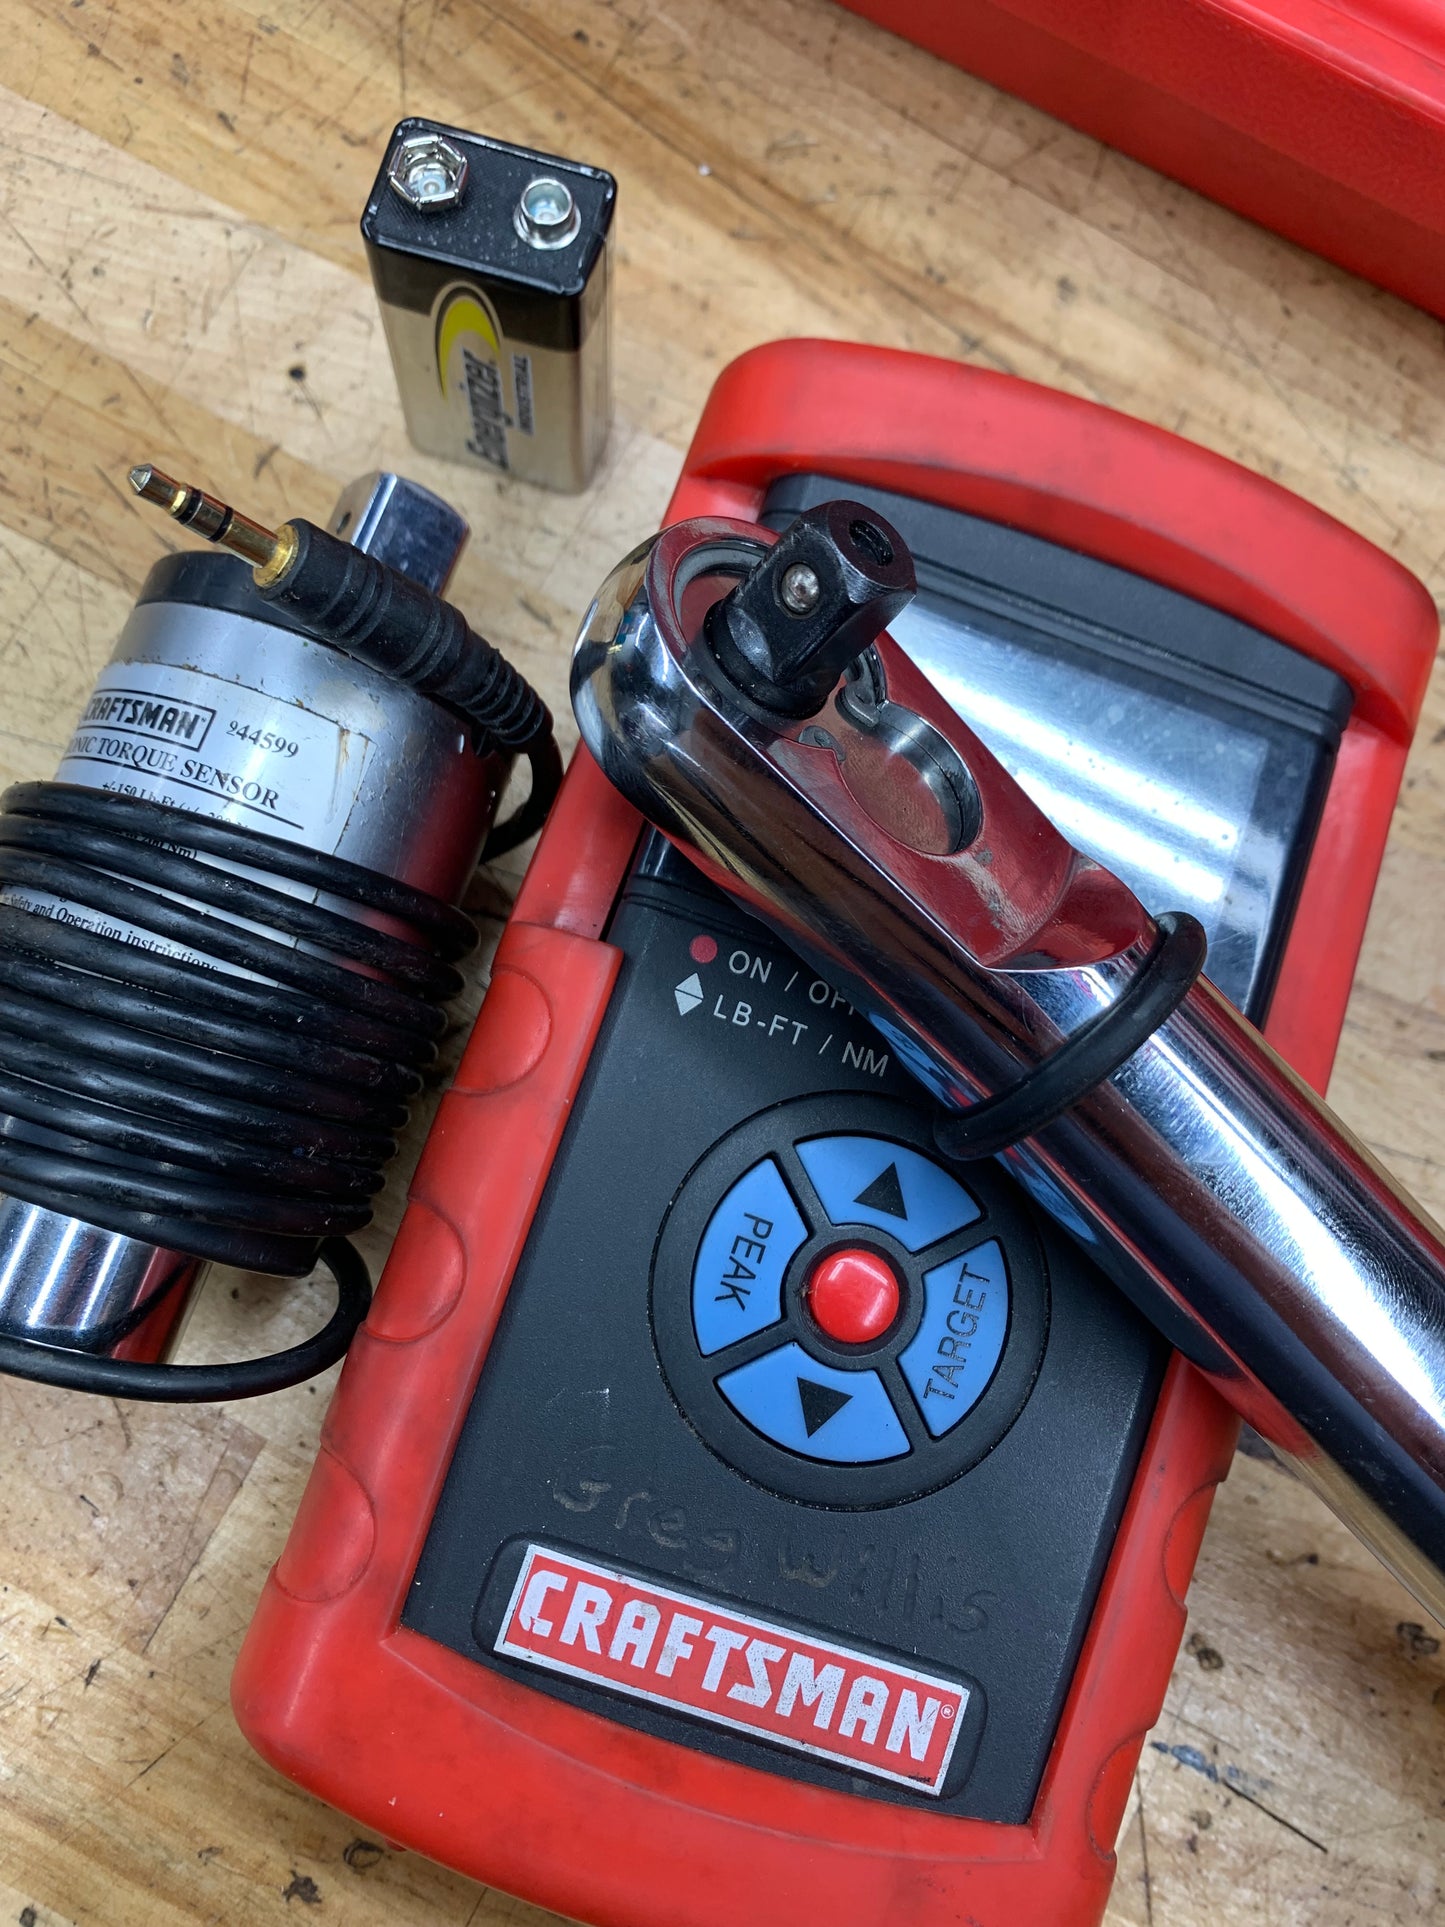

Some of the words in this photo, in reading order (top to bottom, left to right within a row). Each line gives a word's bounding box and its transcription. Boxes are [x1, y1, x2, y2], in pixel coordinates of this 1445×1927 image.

[97, 737, 179, 772] TORQUE
[180, 759, 280, 810] SENSOR
[33, 904, 55, 918] and
[728, 950, 772, 983] ON
[713, 994, 809, 1045] LB-FT
[842, 1042, 889, 1077] NM
[714, 1212, 774, 1312] PEAK
[923, 1262, 991, 1399] TARGET
[517, 1568, 943, 1762] CRAFTSMAN
